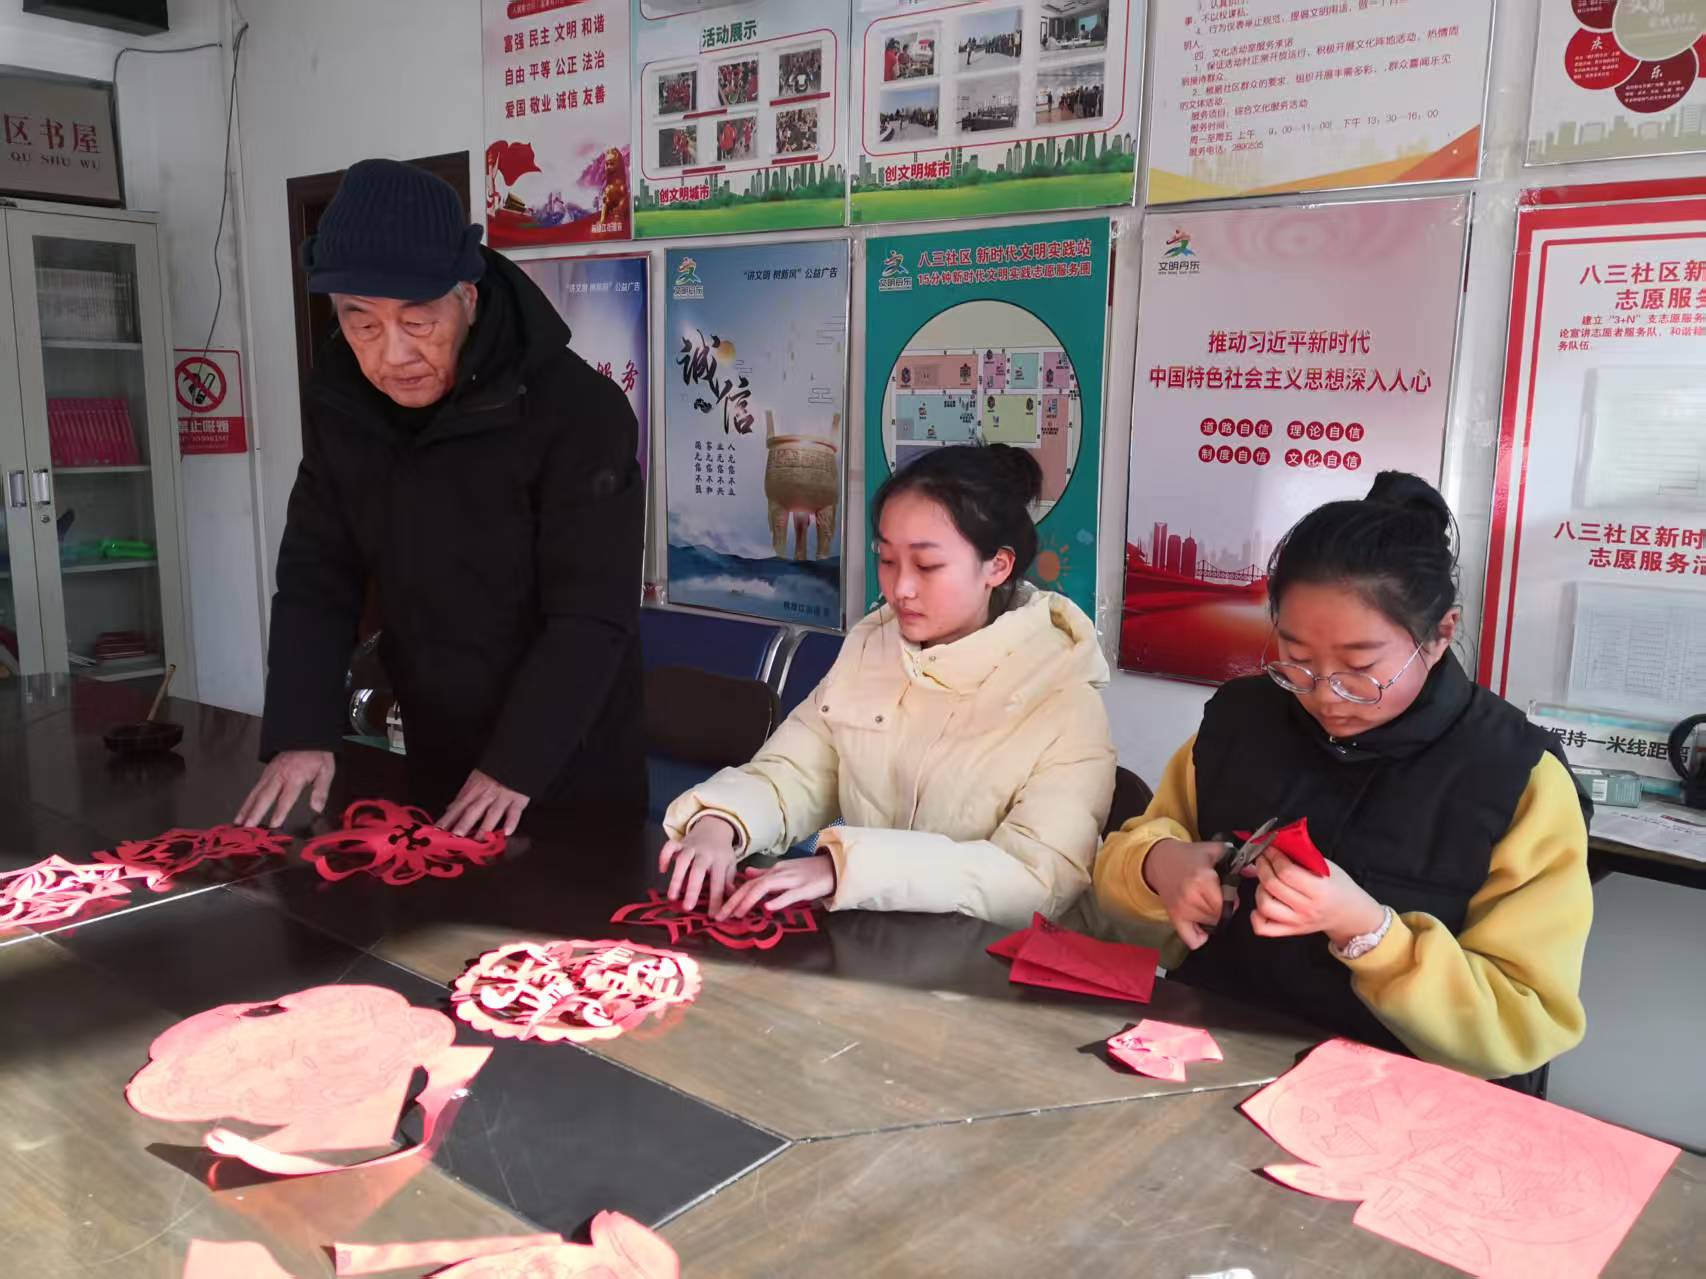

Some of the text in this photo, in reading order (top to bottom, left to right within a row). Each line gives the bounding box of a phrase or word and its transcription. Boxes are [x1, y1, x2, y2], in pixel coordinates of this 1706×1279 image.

[504, 14, 605, 53] 富强 民主 文明 和谐
[702, 20, 757, 48] 活动展示
[505, 49, 605, 86] 自由 平等 公正 法治
[505, 84, 605, 119] 爱国 敬业 诚信 友善
[4, 114, 101, 153] 区书屋
[885, 161, 951, 182] 创文明城市
[659, 185, 710, 203] 创文明城市
[918, 238, 1091, 267] 八三社区 新时代文明实践站
[804, 267, 838, 279] 公益广告
[1580, 259, 1706, 285] 八三社区新
[1208, 330, 1371, 354] 推动习近平新时代
[1150, 365, 1432, 393] 中国特色社会主义思想深入人心
[1201, 418, 1363, 441] 道路自信 理论自信
[1199, 446, 1361, 470] 制度自信 文化自信
[1554, 521, 1706, 549] 八三社区新时
[1539, 724, 1691, 763] 保持一米线距
